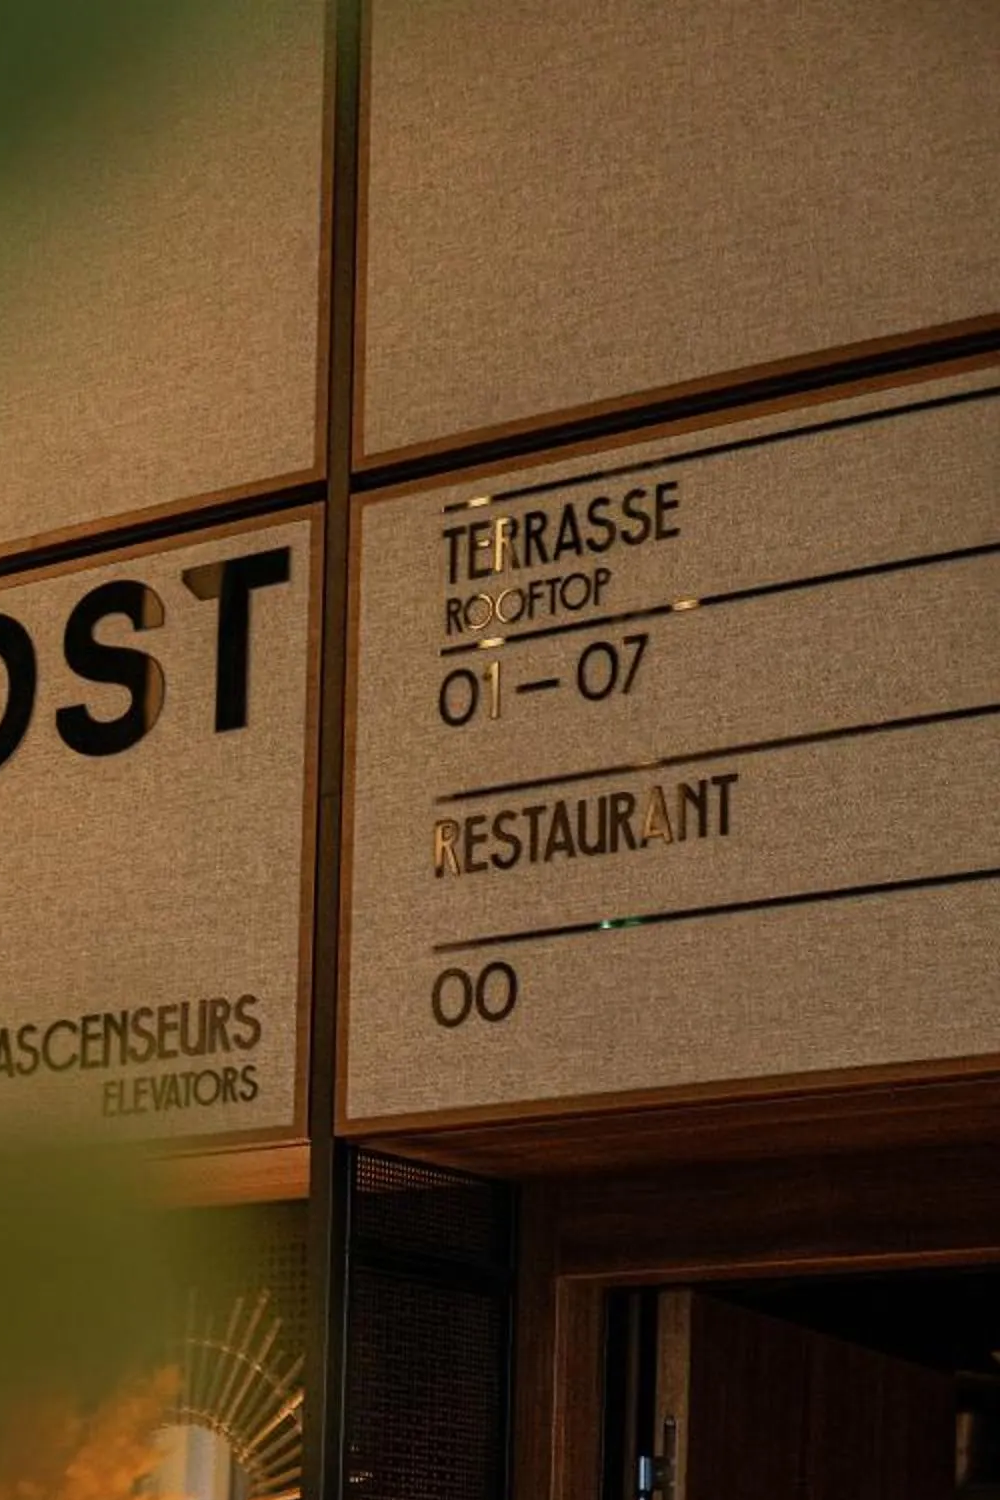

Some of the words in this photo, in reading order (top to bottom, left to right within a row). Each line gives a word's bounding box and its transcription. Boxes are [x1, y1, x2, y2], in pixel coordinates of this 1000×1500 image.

[443, 481, 681, 584] TERRASSE
[446, 567, 611, 635] ROOFTOP
[439, 660, 501, 726] 01
[577, 634, 648, 700] 07
[433, 773, 739, 878] RESTAURANT
[102, 1065, 258, 1118] ELEVATORS
